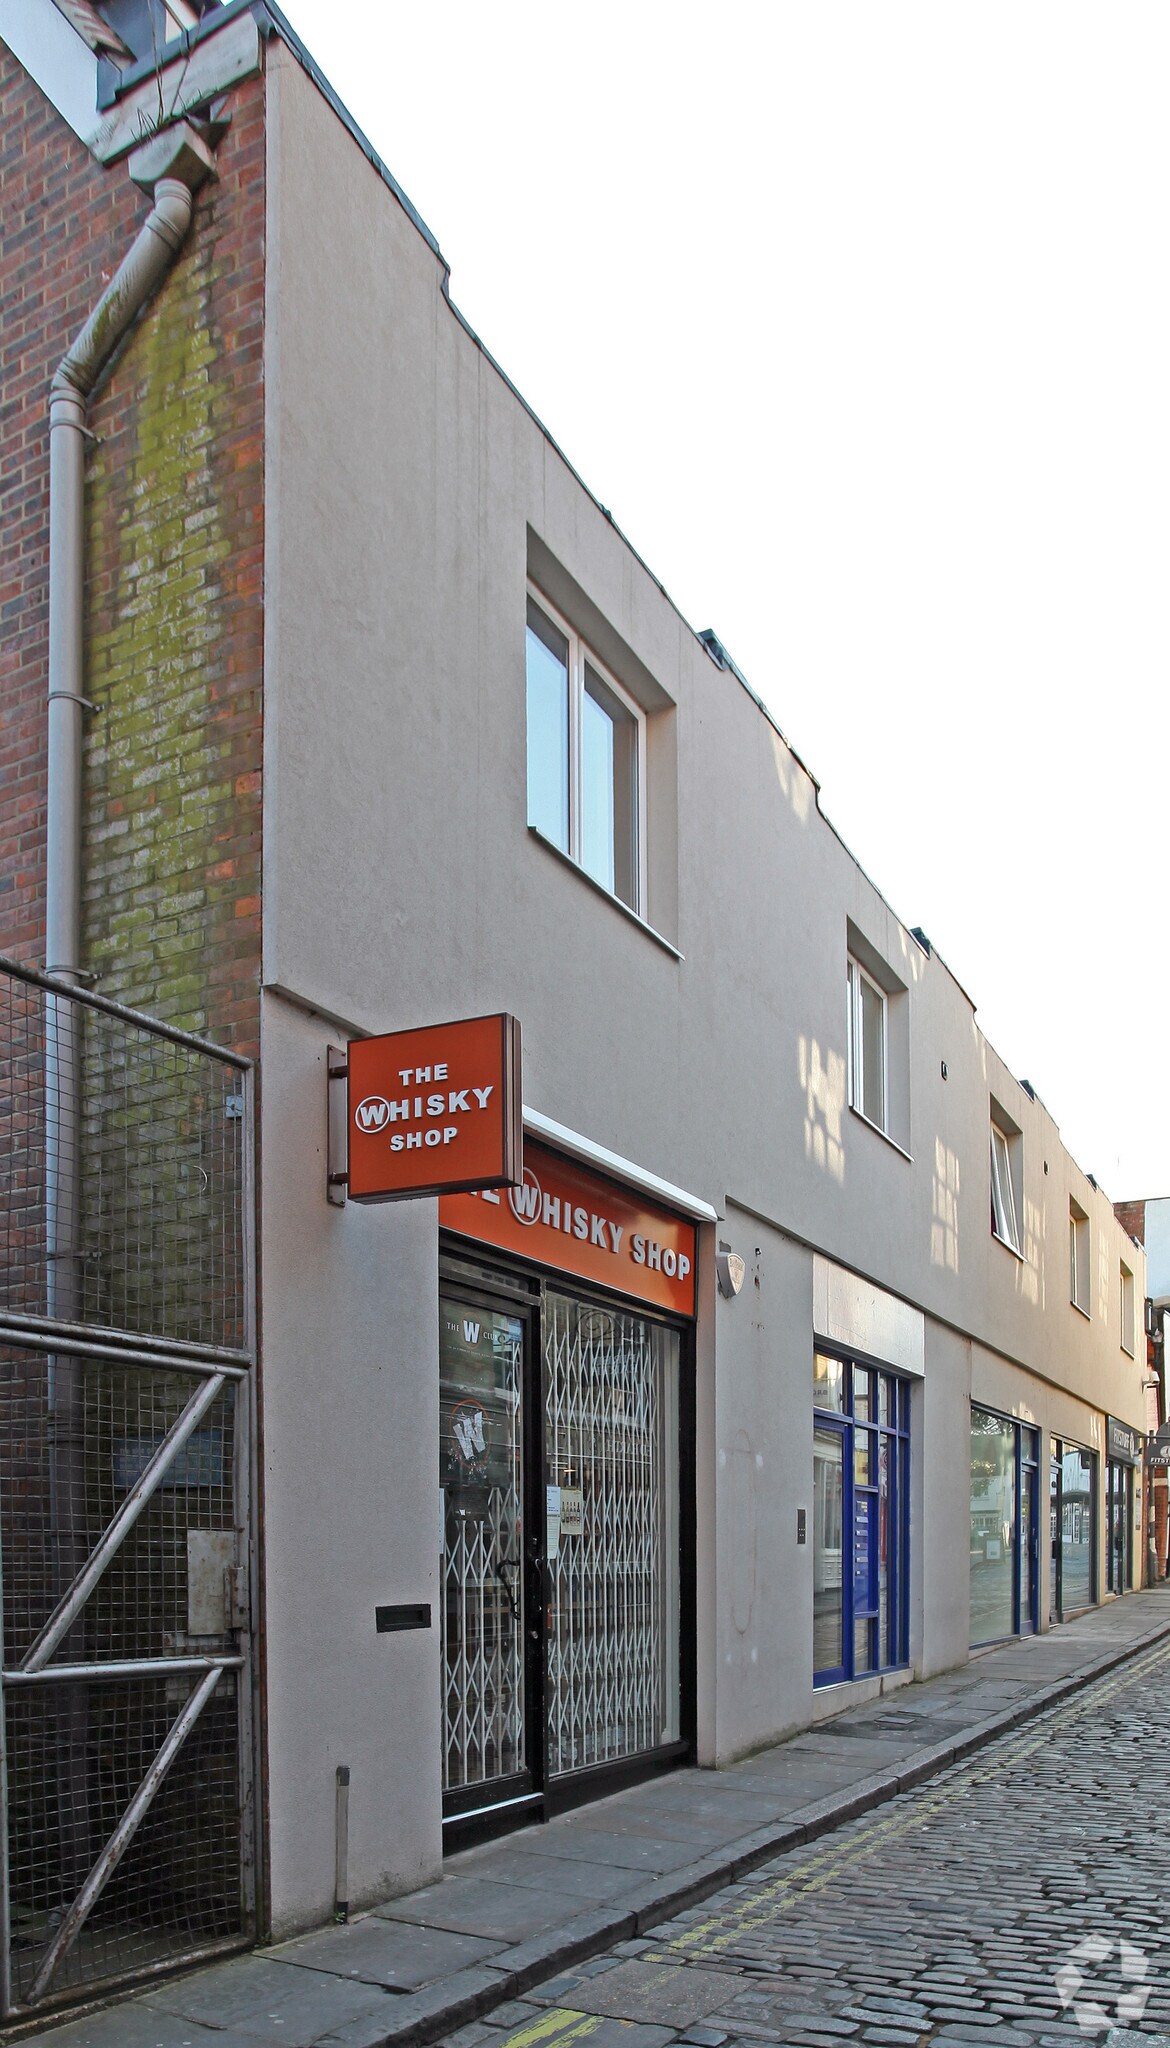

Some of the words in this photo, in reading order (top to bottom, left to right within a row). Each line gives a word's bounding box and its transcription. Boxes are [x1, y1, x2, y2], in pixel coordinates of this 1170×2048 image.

[398, 1063, 448, 1086] THE
[359, 1085, 494, 1127] WHISKY
[390, 1127, 458, 1151] SHOP
[513, 1183, 624, 1253] WHISKY
[631, 1233, 691, 1281] SHOP
[446, 1322, 460, 1332] THE
[463, 1320, 480, 1344] W
